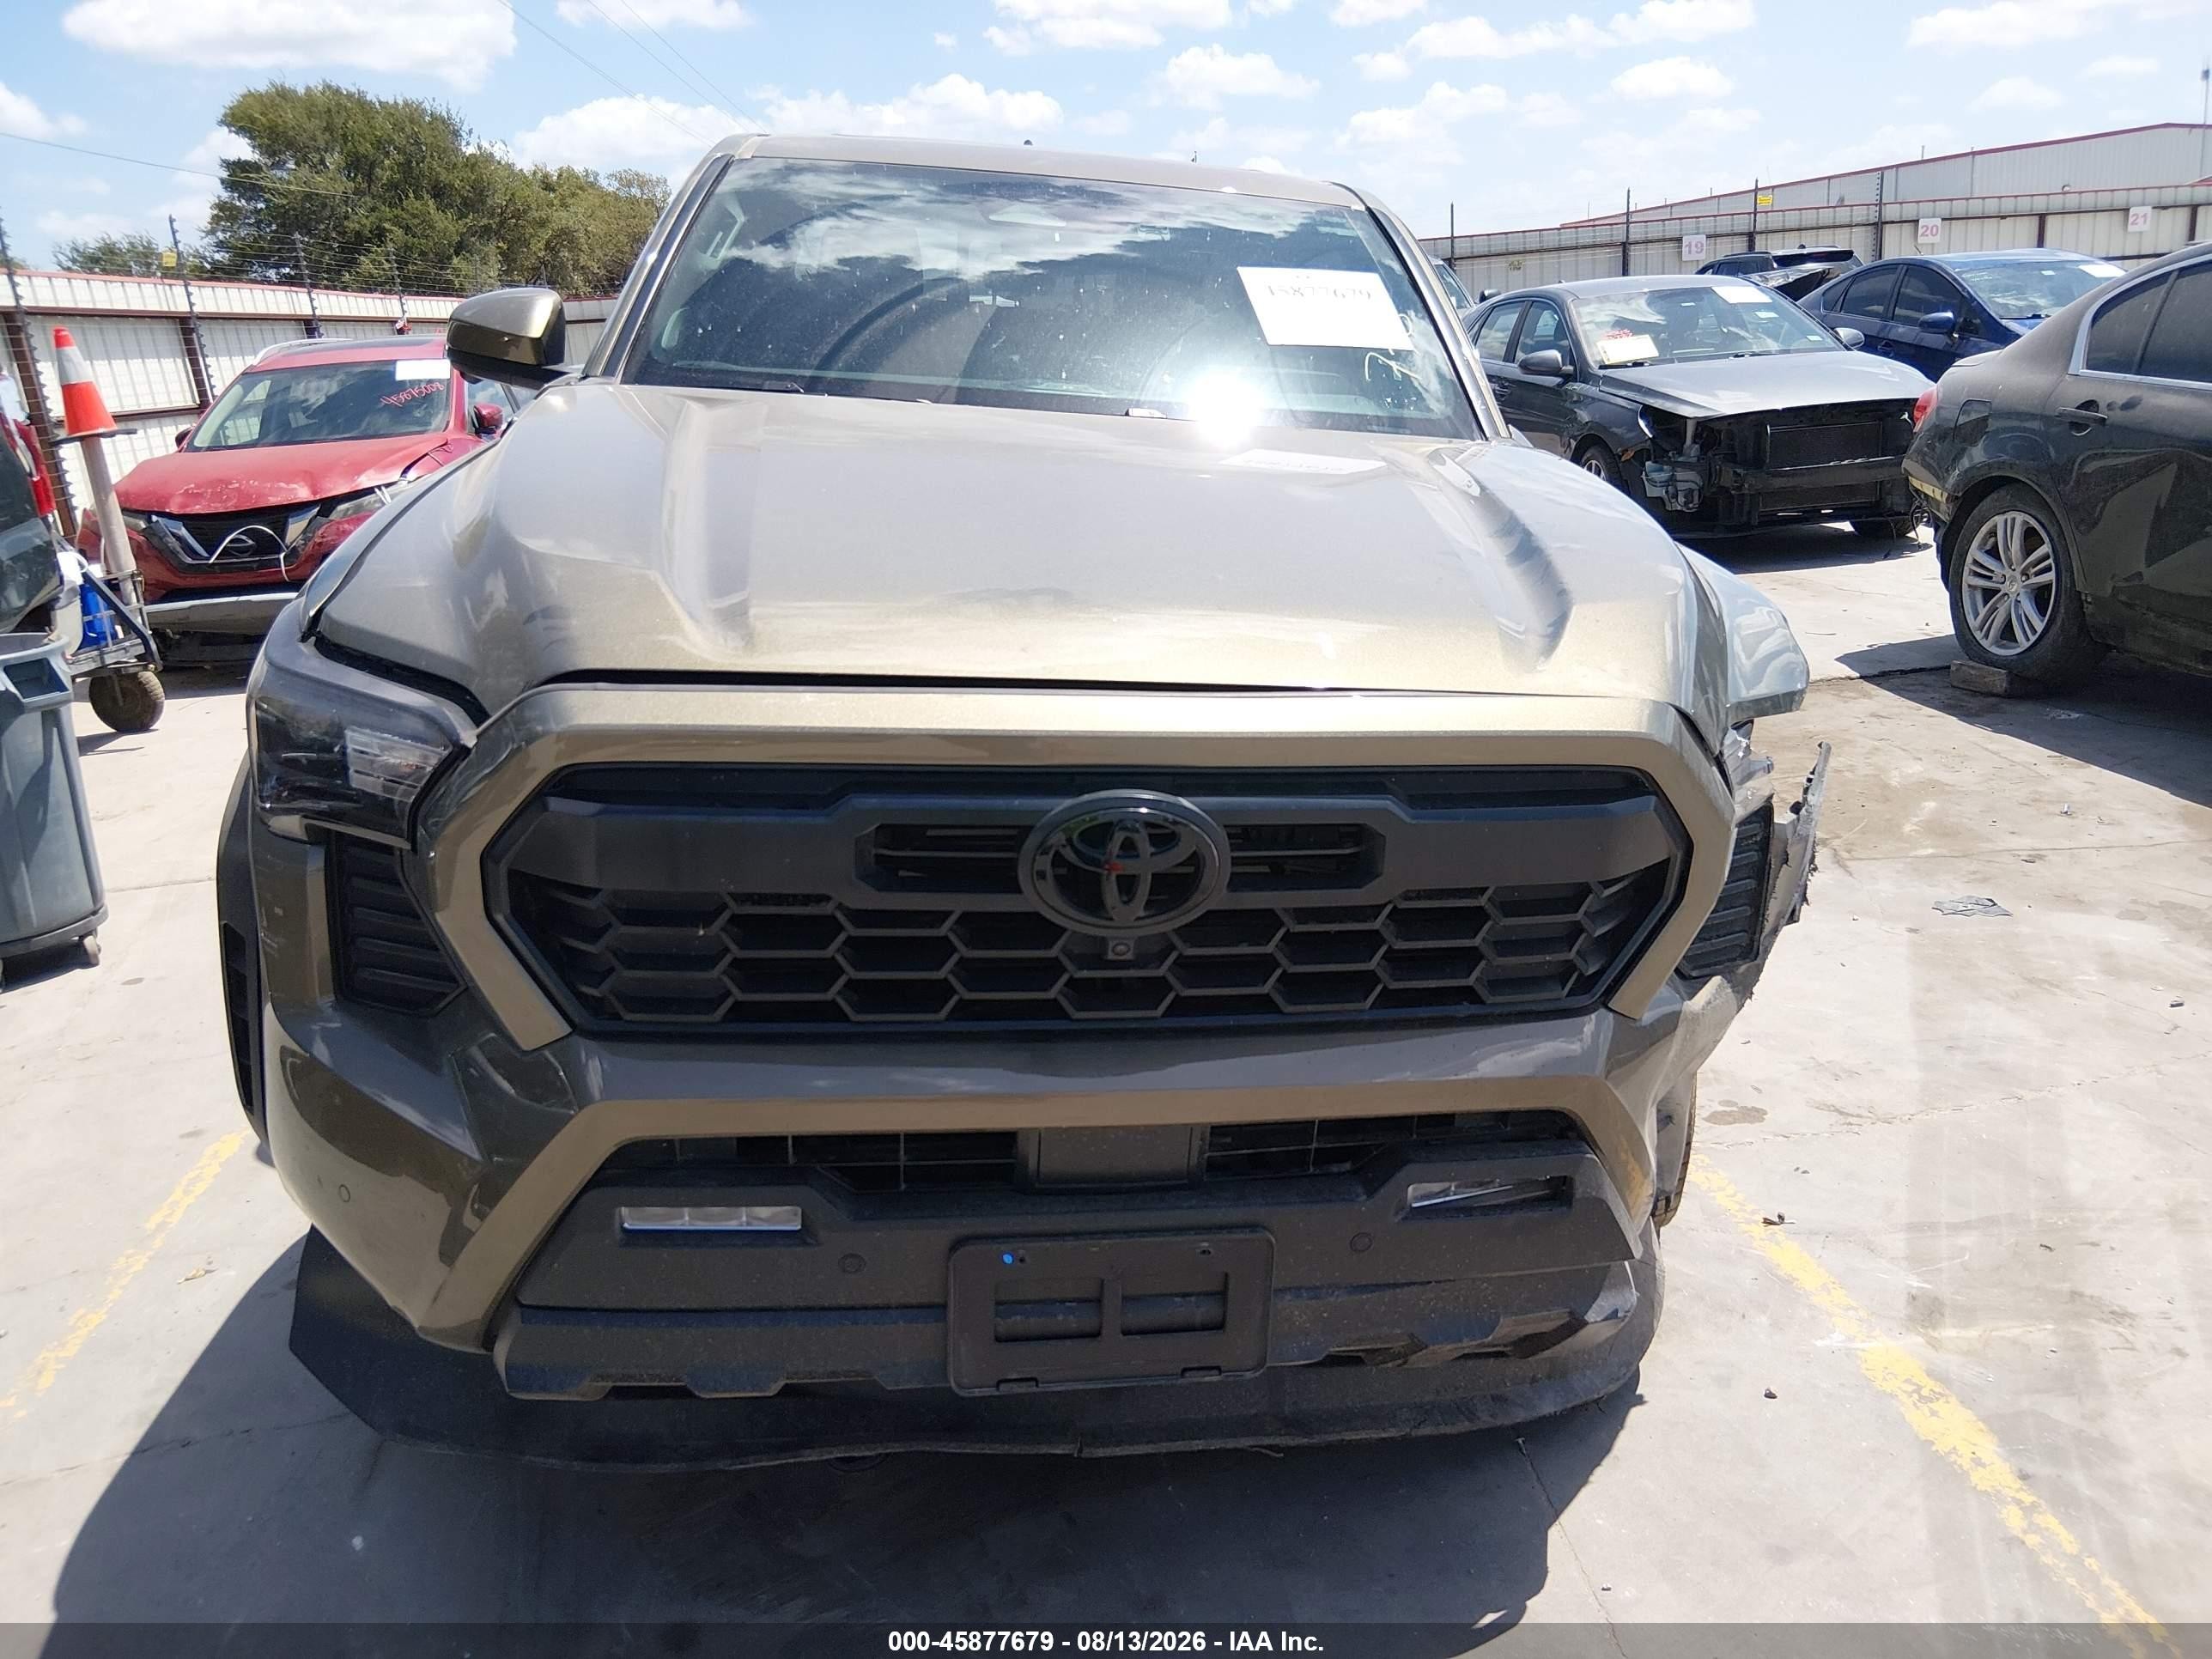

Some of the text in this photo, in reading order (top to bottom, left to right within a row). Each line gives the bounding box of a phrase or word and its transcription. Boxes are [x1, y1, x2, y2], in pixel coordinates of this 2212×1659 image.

[2130, 213, 2148, 226] 21
[1920, 224, 1939, 237] 20
[1684, 240, 1705, 255] 19
